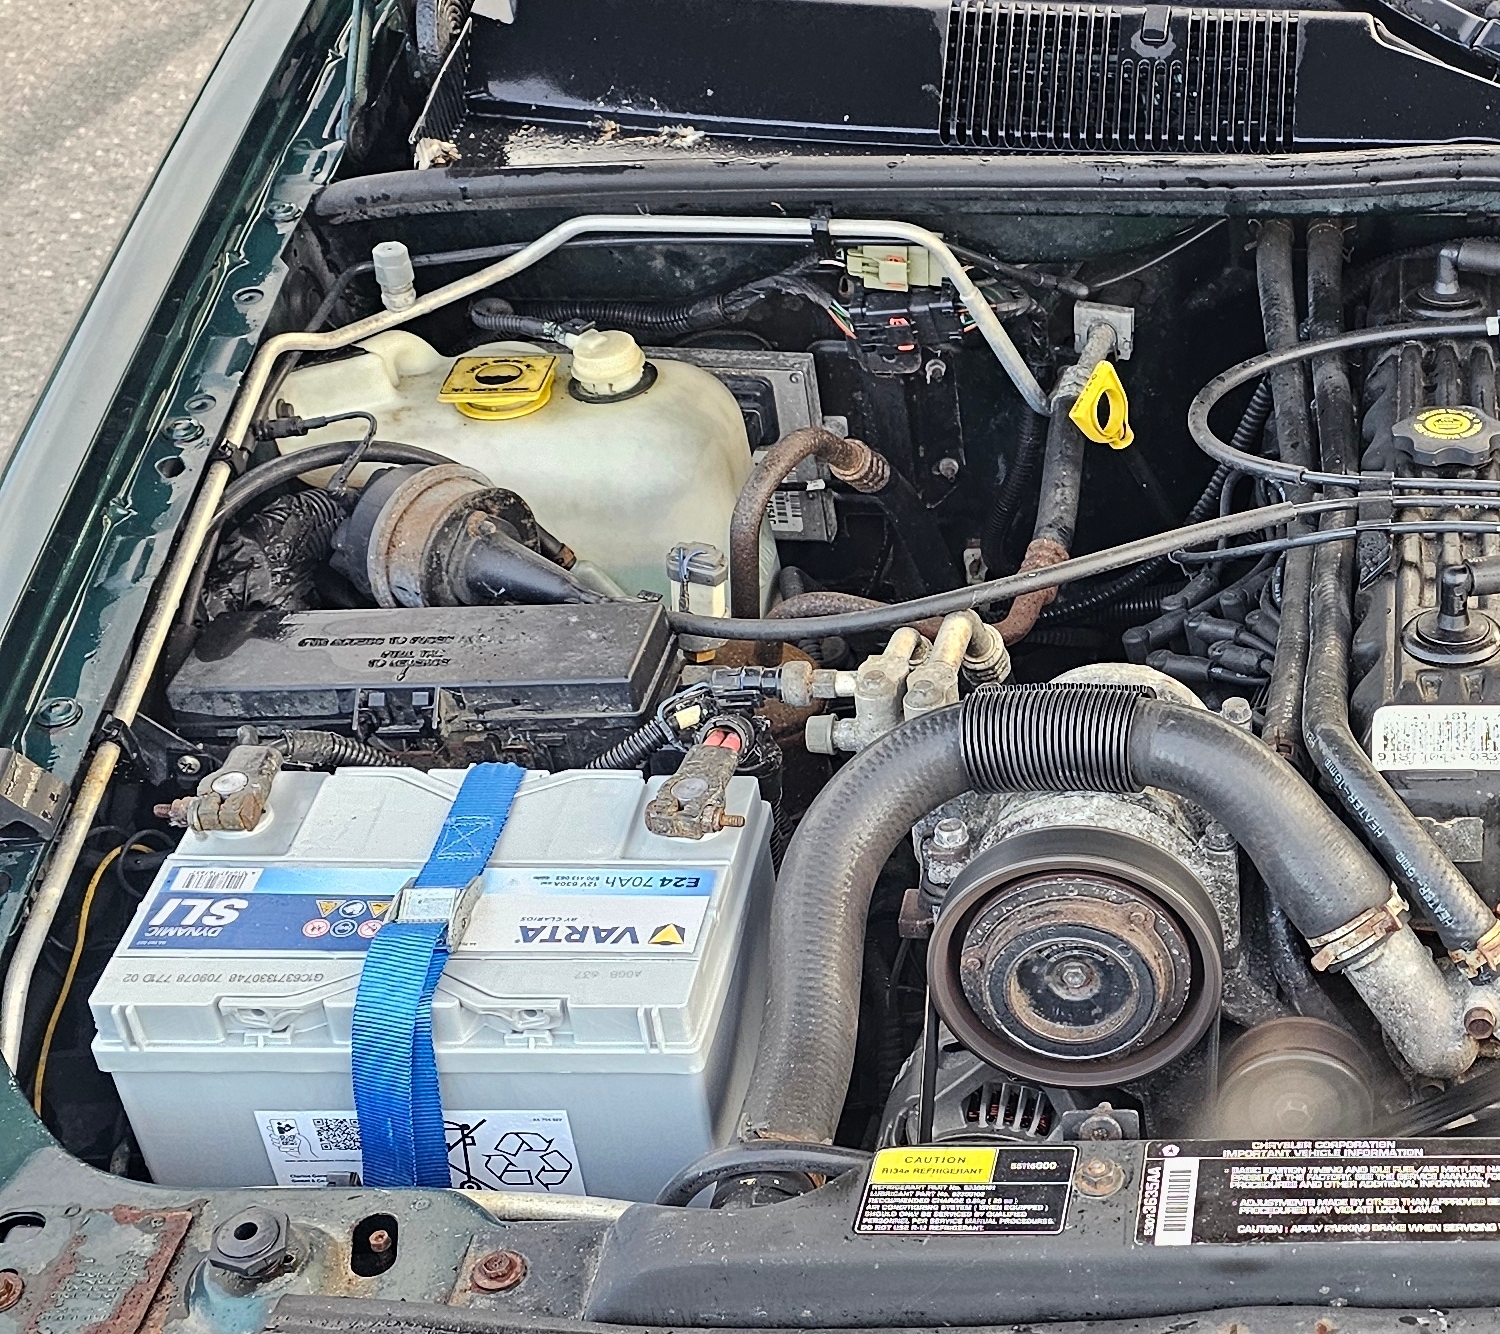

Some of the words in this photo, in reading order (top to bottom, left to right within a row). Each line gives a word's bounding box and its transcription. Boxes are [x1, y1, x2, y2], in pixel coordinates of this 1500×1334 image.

[605, 877, 654, 888] 70Ah
[660, 877, 700, 888] E24
[148, 898, 249, 926] SLI
[144, 926, 223, 937] DYNAMIC
[518, 926, 639, 944] VARTA
[123, 973, 139, 983] 02
[176, 973, 222, 983] 709078
[1252, 1141, 1312, 1149] CHRYSLER
[1315, 1141, 1395, 1149] CORPORATION
[1223, 1149, 1293, 1158] IMPORTANT
[1294, 1149, 1340, 1158] VEHICLE
[1344, 1149, 1423, 1158] INFORMATION
[1238, 1207, 1307, 1215] PROCEDURES
[1308, 1207, 1332, 1215] MAY
[1333, 1207, 1373, 1215] VIOLATE
[1237, 1225, 1283, 1233] CAUTION
[1290, 1225, 1321, 1233] APPLY
[1324, 1225, 1370, 1233] PARKING
[1373, 1223, 1406, 1232] BRAKE
[1408, 1223, 1441, 1232] WHEN
[1443, 1223, 1497, 1232] SERVICING
